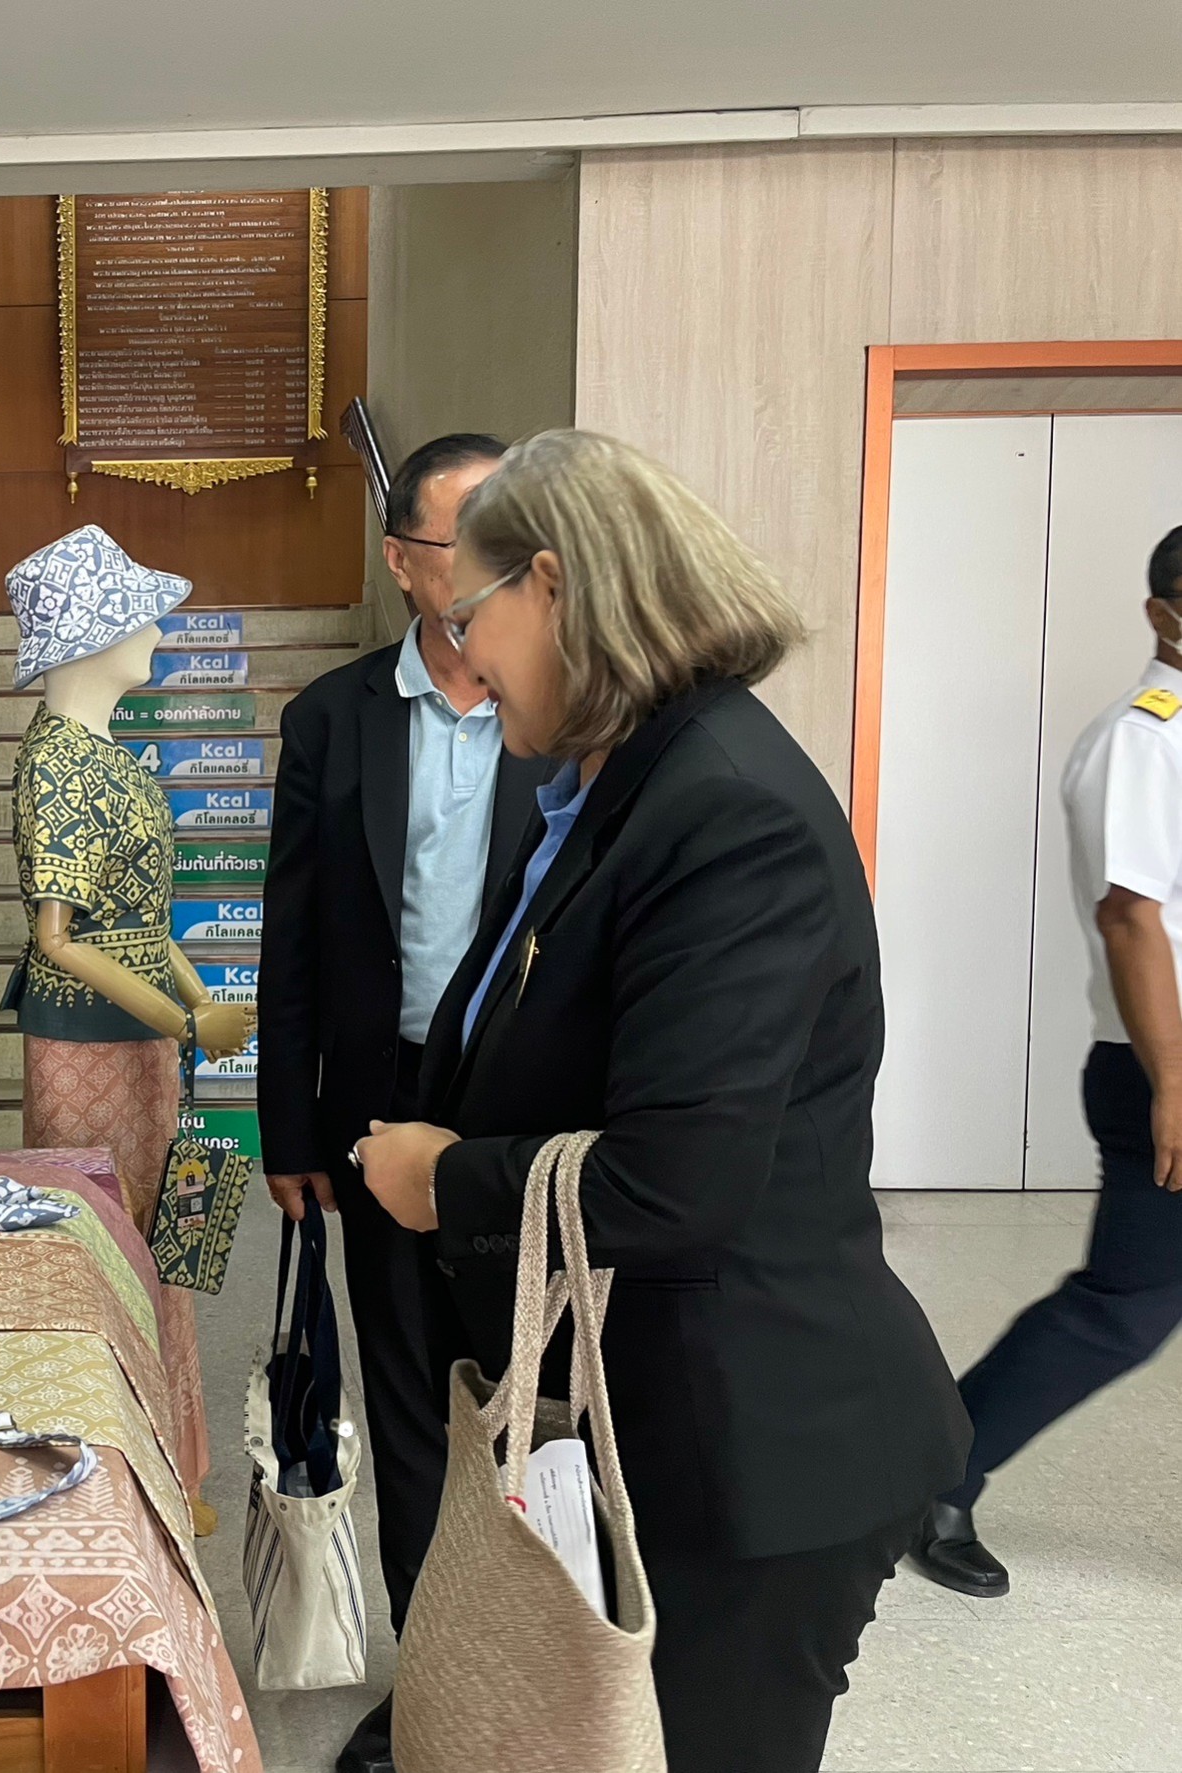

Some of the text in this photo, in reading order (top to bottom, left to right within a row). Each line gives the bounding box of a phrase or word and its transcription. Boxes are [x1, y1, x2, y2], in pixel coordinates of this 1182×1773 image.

[186, 615, 224, 629] Kcal
[190, 654, 229, 669] Kcal
[154, 705, 241, 720] ออกกำลังกาย
[201, 742, 243, 758] Kcal
[189, 760, 249, 774] กิโลแคลอรี่
[206, 792, 250, 808] Kcal
[195, 810, 257, 824] กิโลแคลอรี่
